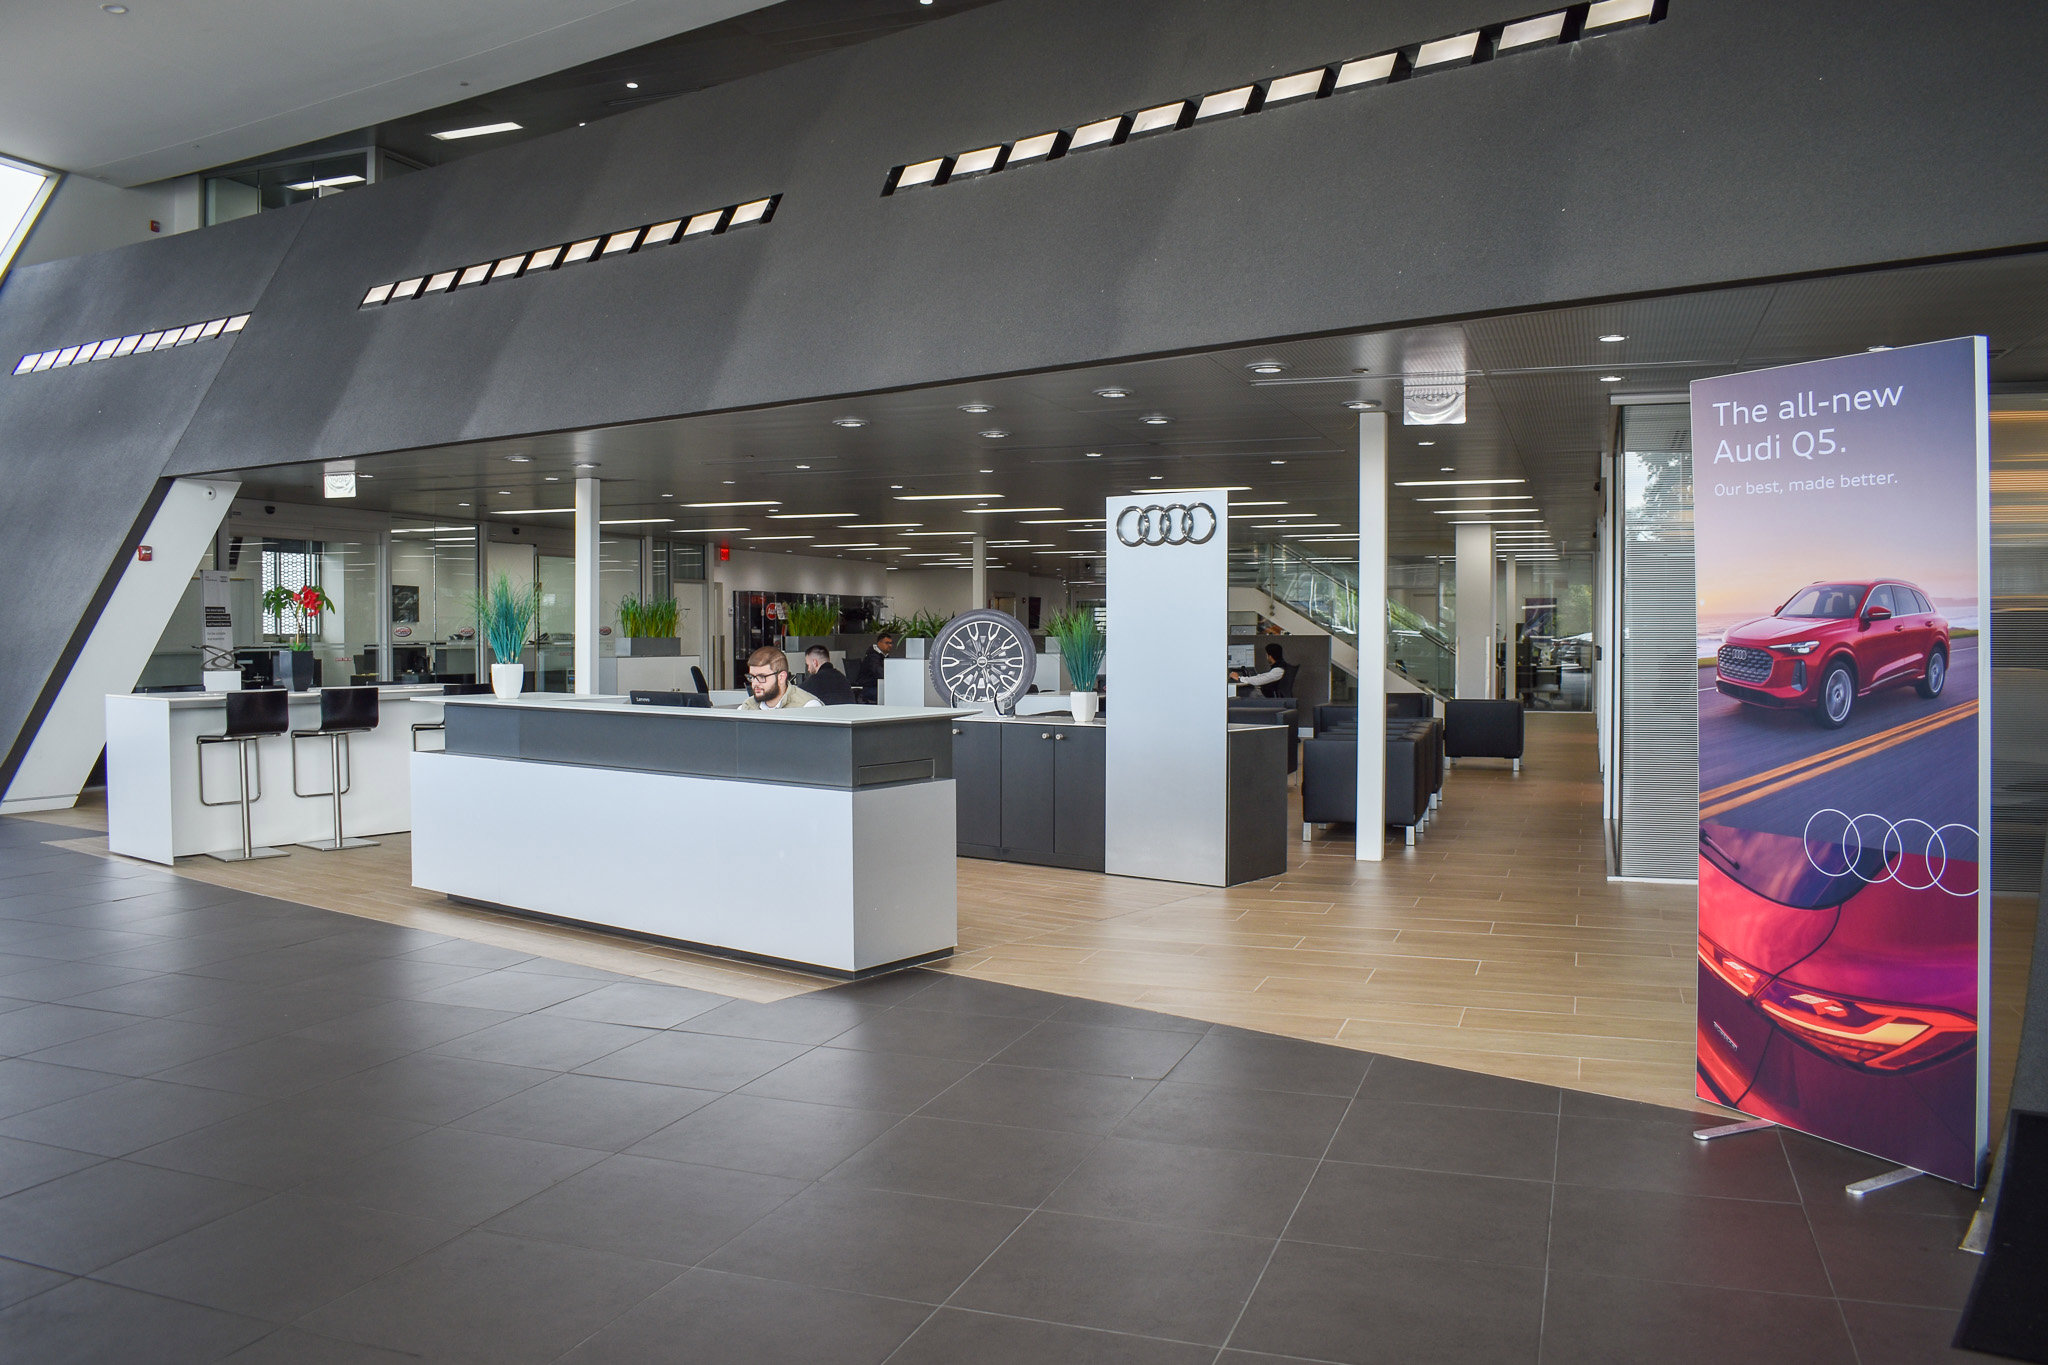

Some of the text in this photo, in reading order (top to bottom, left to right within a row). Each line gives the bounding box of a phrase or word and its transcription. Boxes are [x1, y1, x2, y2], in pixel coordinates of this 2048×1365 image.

[1712, 385, 1904, 426] The all-new
[1713, 428, 1846, 464] Audi Q5.
[1714, 472, 1898, 496] Our best, made better.
